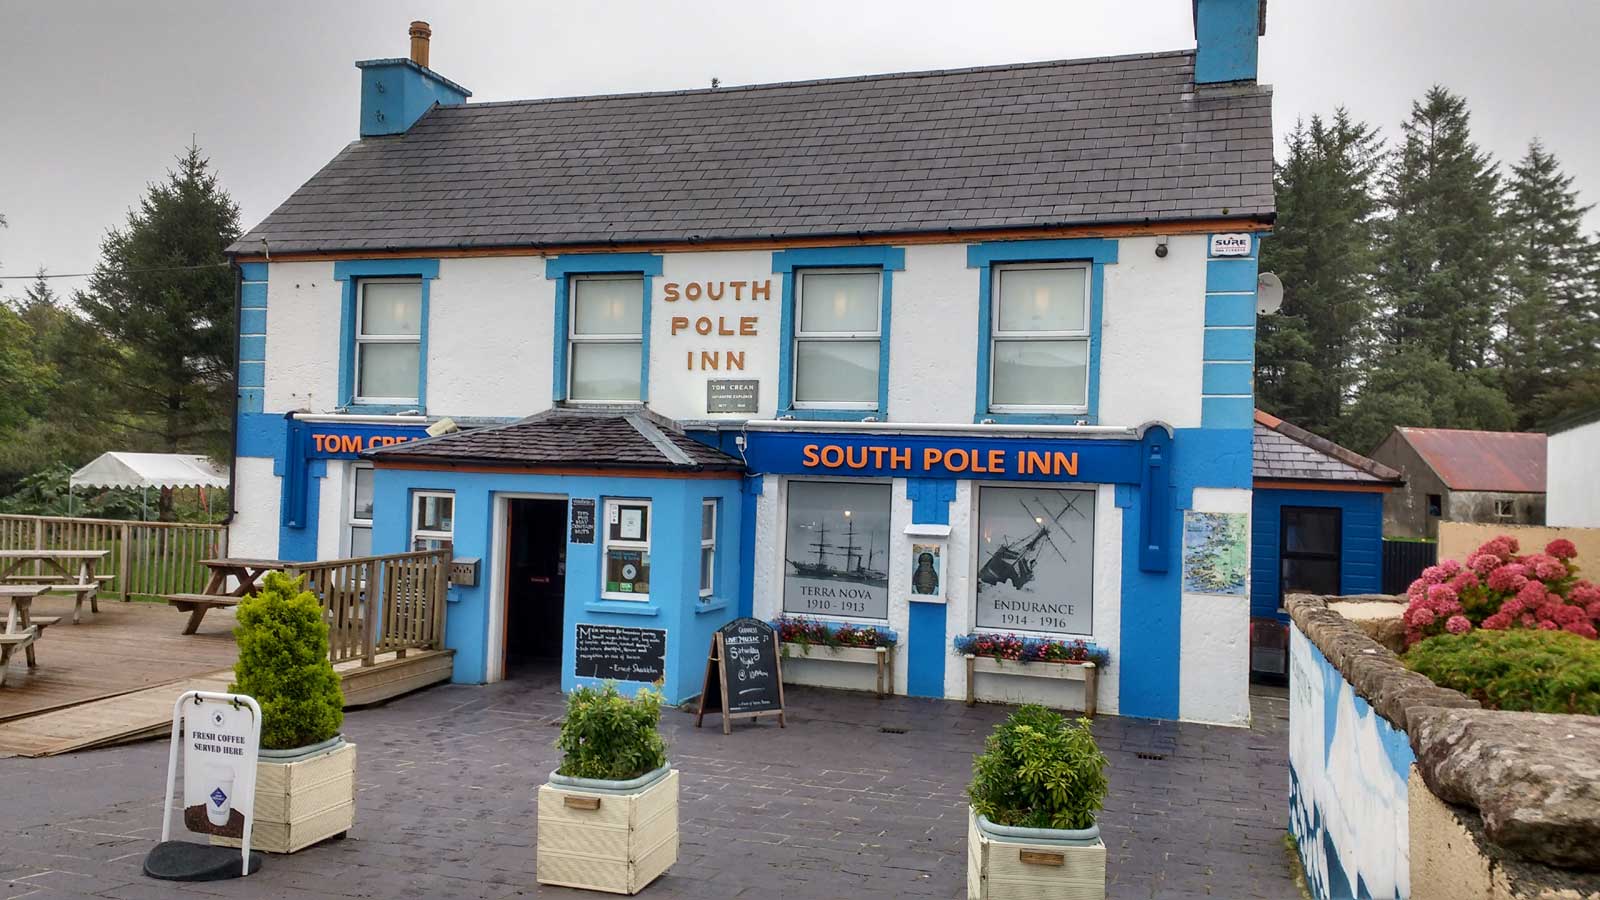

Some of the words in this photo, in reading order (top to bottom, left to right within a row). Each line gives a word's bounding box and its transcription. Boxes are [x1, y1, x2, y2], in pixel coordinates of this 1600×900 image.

[664, 280, 771, 302] SOUTH
[671, 316, 759, 336] POLE
[687, 351, 745, 371] INN
[312, 434, 363, 454] TOM
[802, 444, 912, 470] SOUTH
[923, 448, 1006, 474] POLE
[1017, 451, 1079, 477] INN
[800, 586, 836, 597] TERRA
[840, 588, 872, 600] NOVA
[807, 600, 830, 609] 1910
[842, 602, 865, 612] 1913
[994, 600, 1075, 615] ENDURANCE
[1002, 614, 1027, 625] 1914
[1040, 617, 1066, 628] 1916
[192, 731, 216, 742] FRESH
[217, 733, 246, 744] COFFEE
[193, 742, 222, 754] SERVED
[223, 745, 244, 756] HERE
